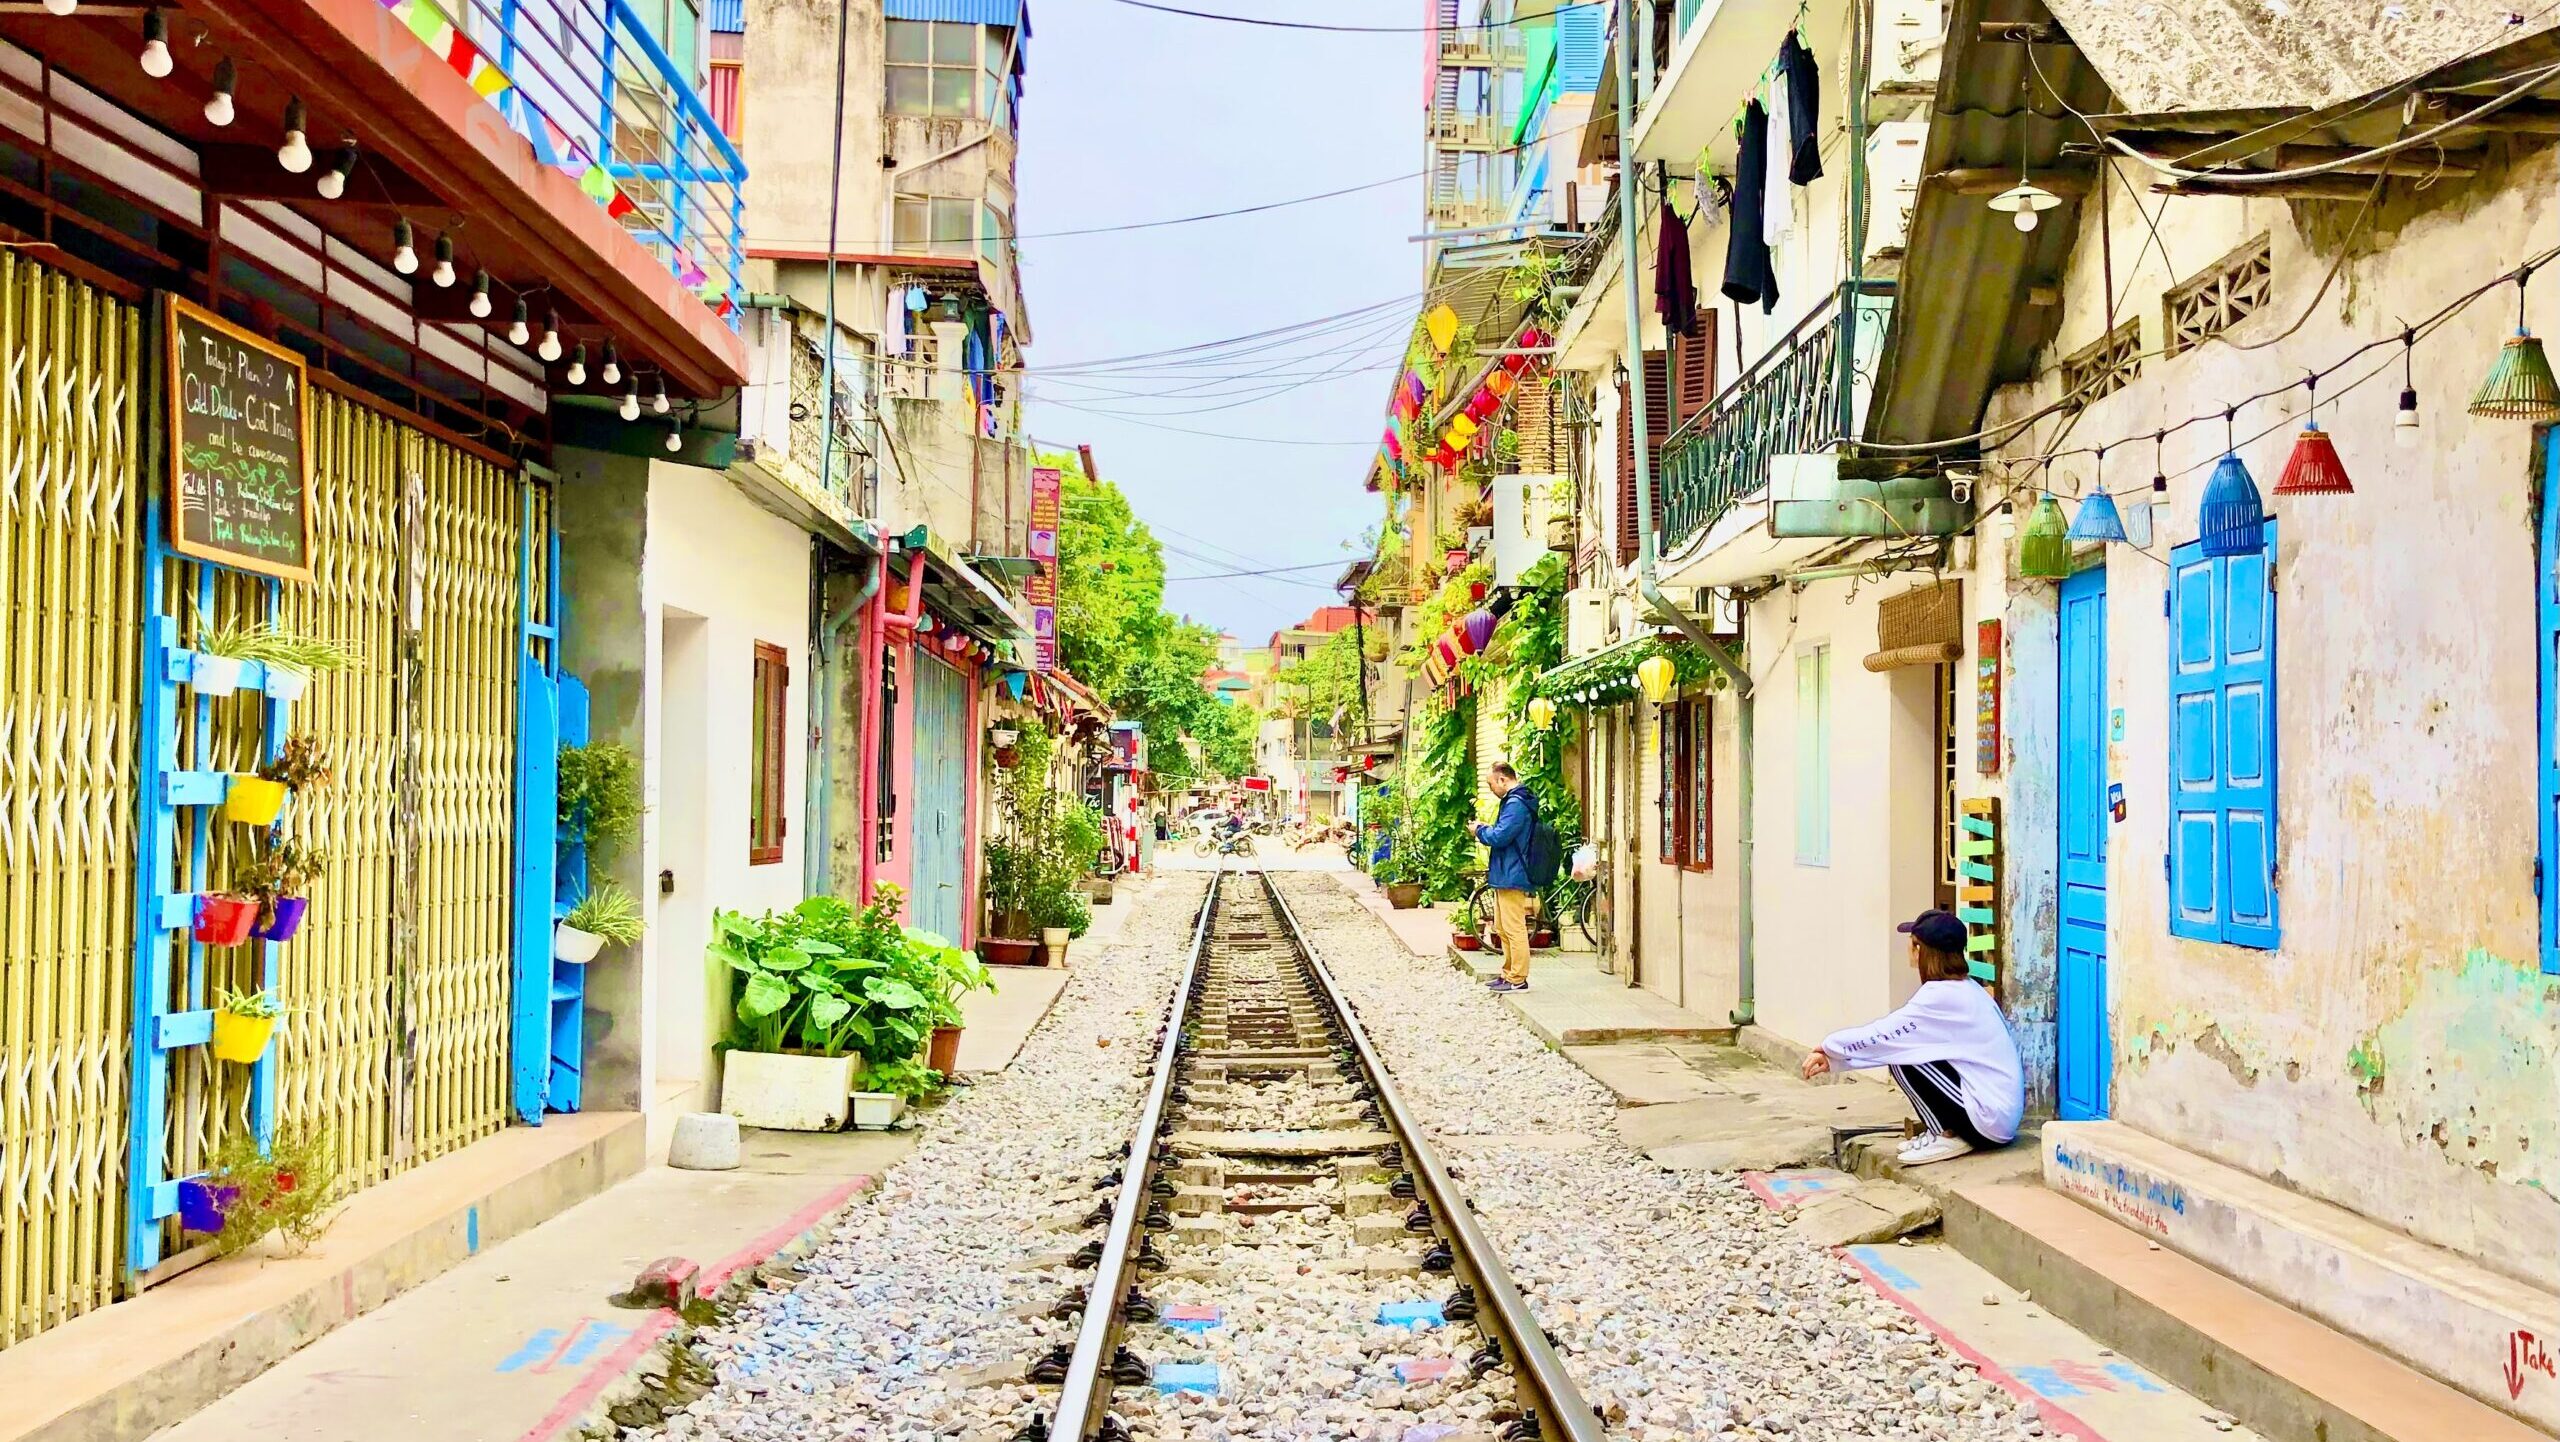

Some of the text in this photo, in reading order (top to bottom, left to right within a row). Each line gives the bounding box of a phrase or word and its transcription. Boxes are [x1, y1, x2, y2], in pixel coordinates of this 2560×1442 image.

[238, 350, 261, 384] Plan
[185, 373, 208, 414] Cold
[246, 394, 268, 432] Cool
[269, 402, 295, 441] Train
[209, 422, 289, 467] and be awesome
[2517, 1330, 2557, 1379] Take
